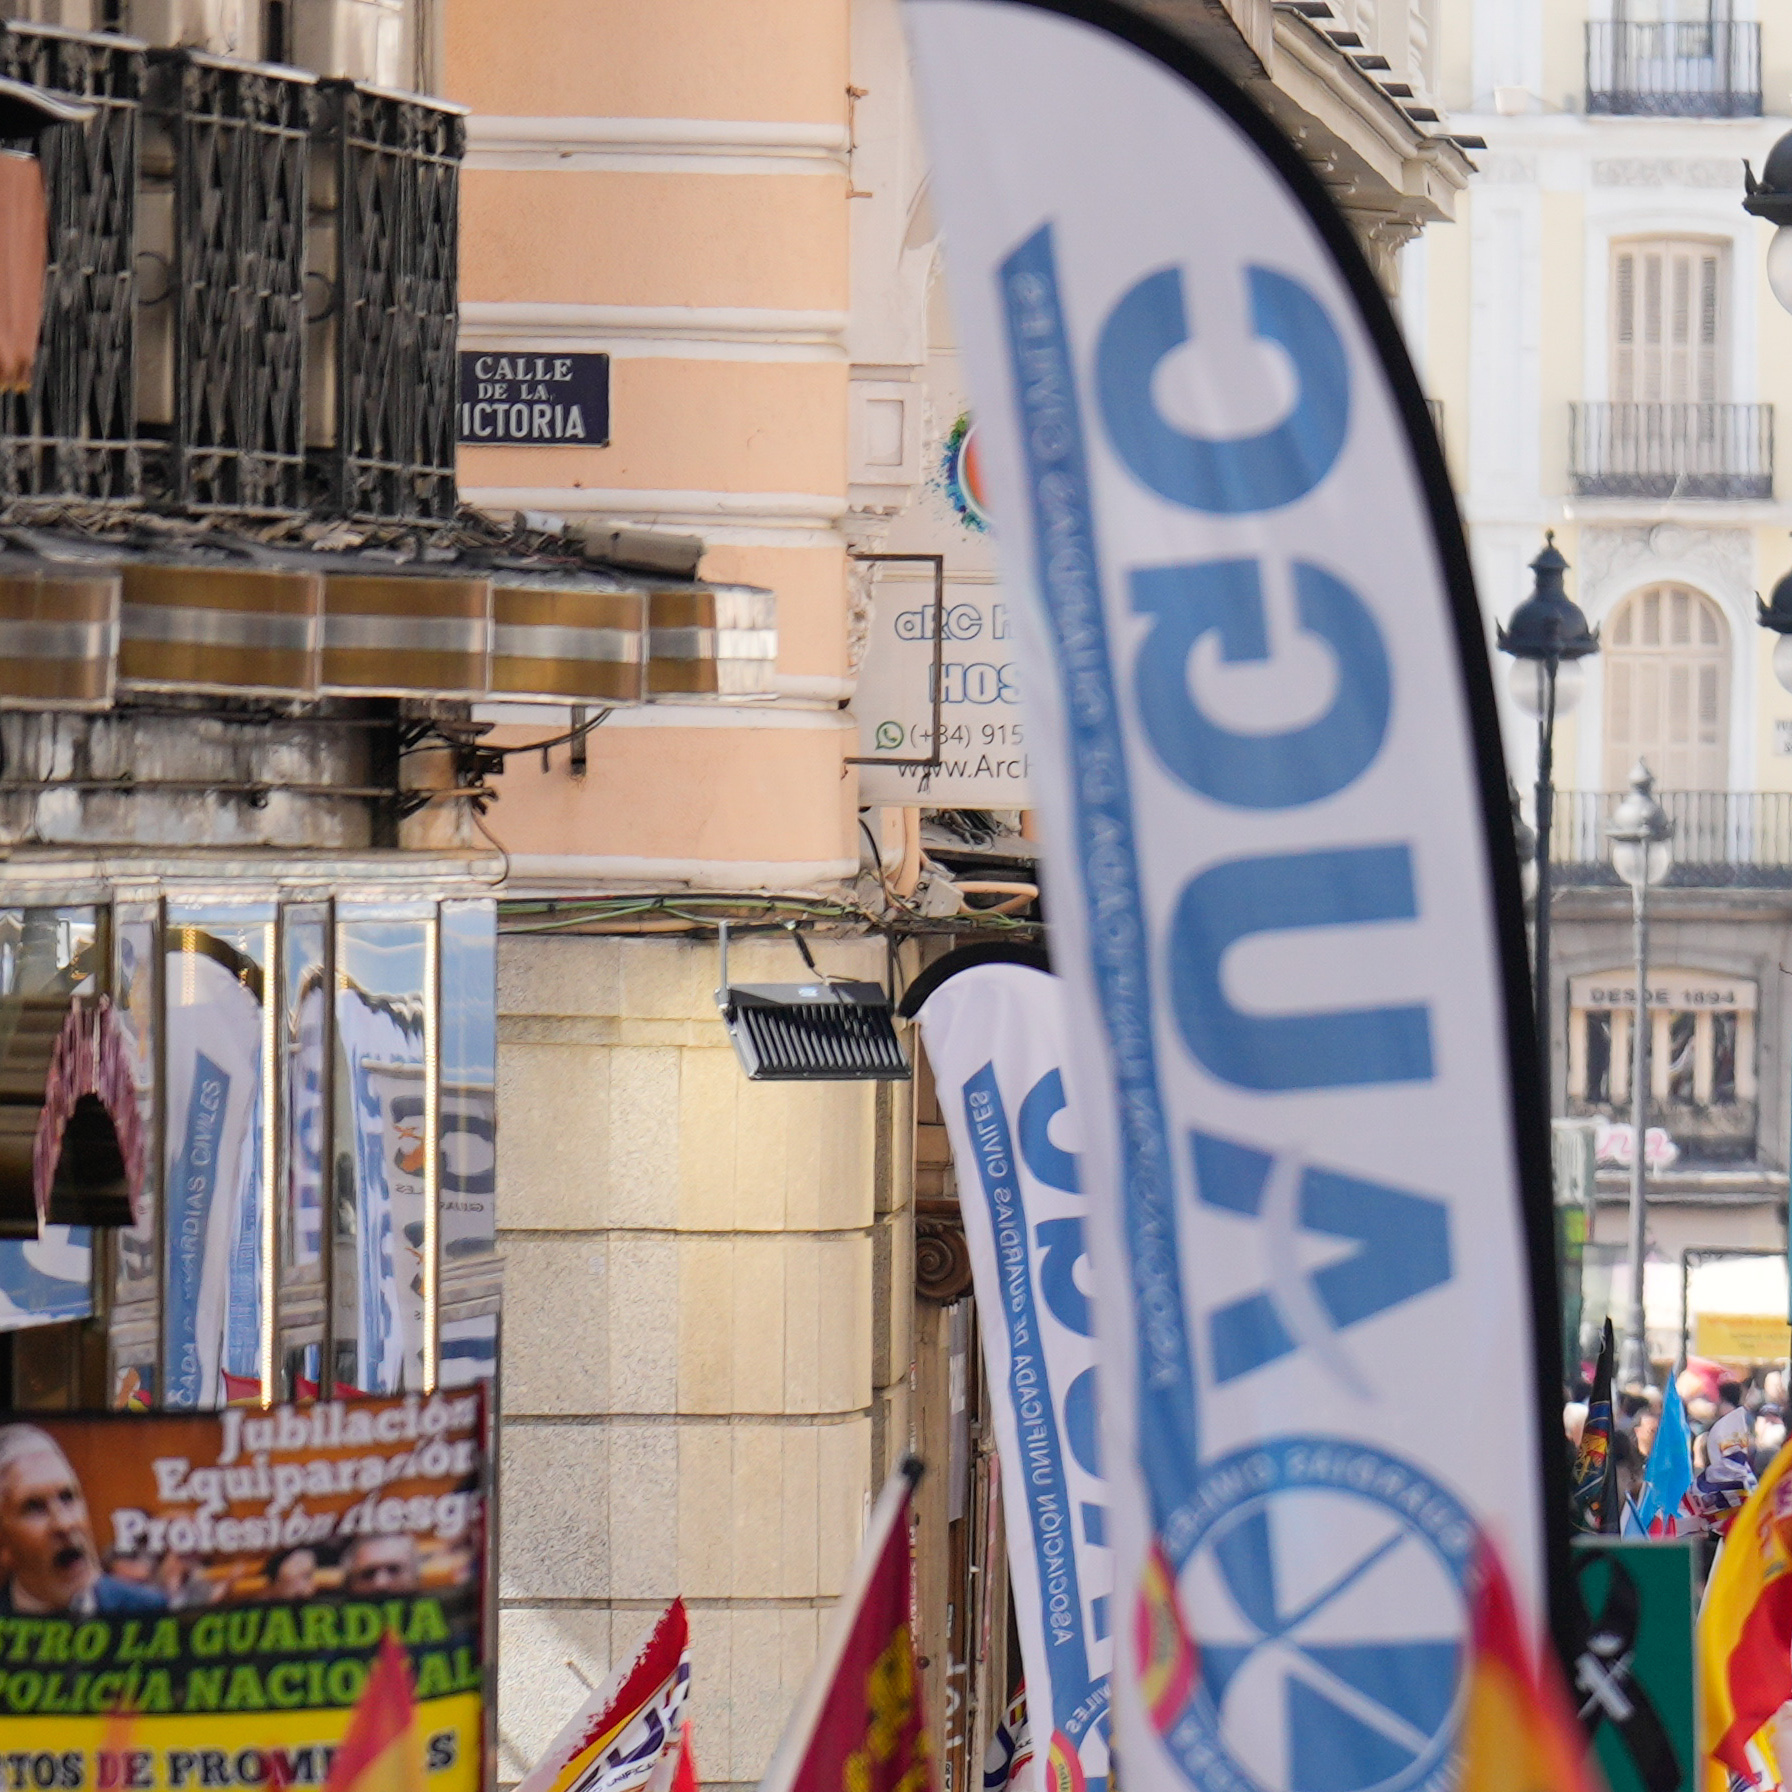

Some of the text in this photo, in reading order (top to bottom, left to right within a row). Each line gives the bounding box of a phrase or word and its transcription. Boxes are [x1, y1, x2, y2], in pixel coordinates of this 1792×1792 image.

[474, 356, 574, 381] CALLE
[478, 382, 550, 400] DE LA
[457, 402, 587, 439] ICTORIA
[217, 1394, 478, 1464] Jubilación
[152, 1437, 475, 1513] Equiparación
[112, 1502, 336, 1554] Profesión
[116, 1619, 181, 1661] LA
[191, 1603, 449, 1656] GUARDIA
[0, 1645, 484, 1714] OLICÍA NACIOAL
